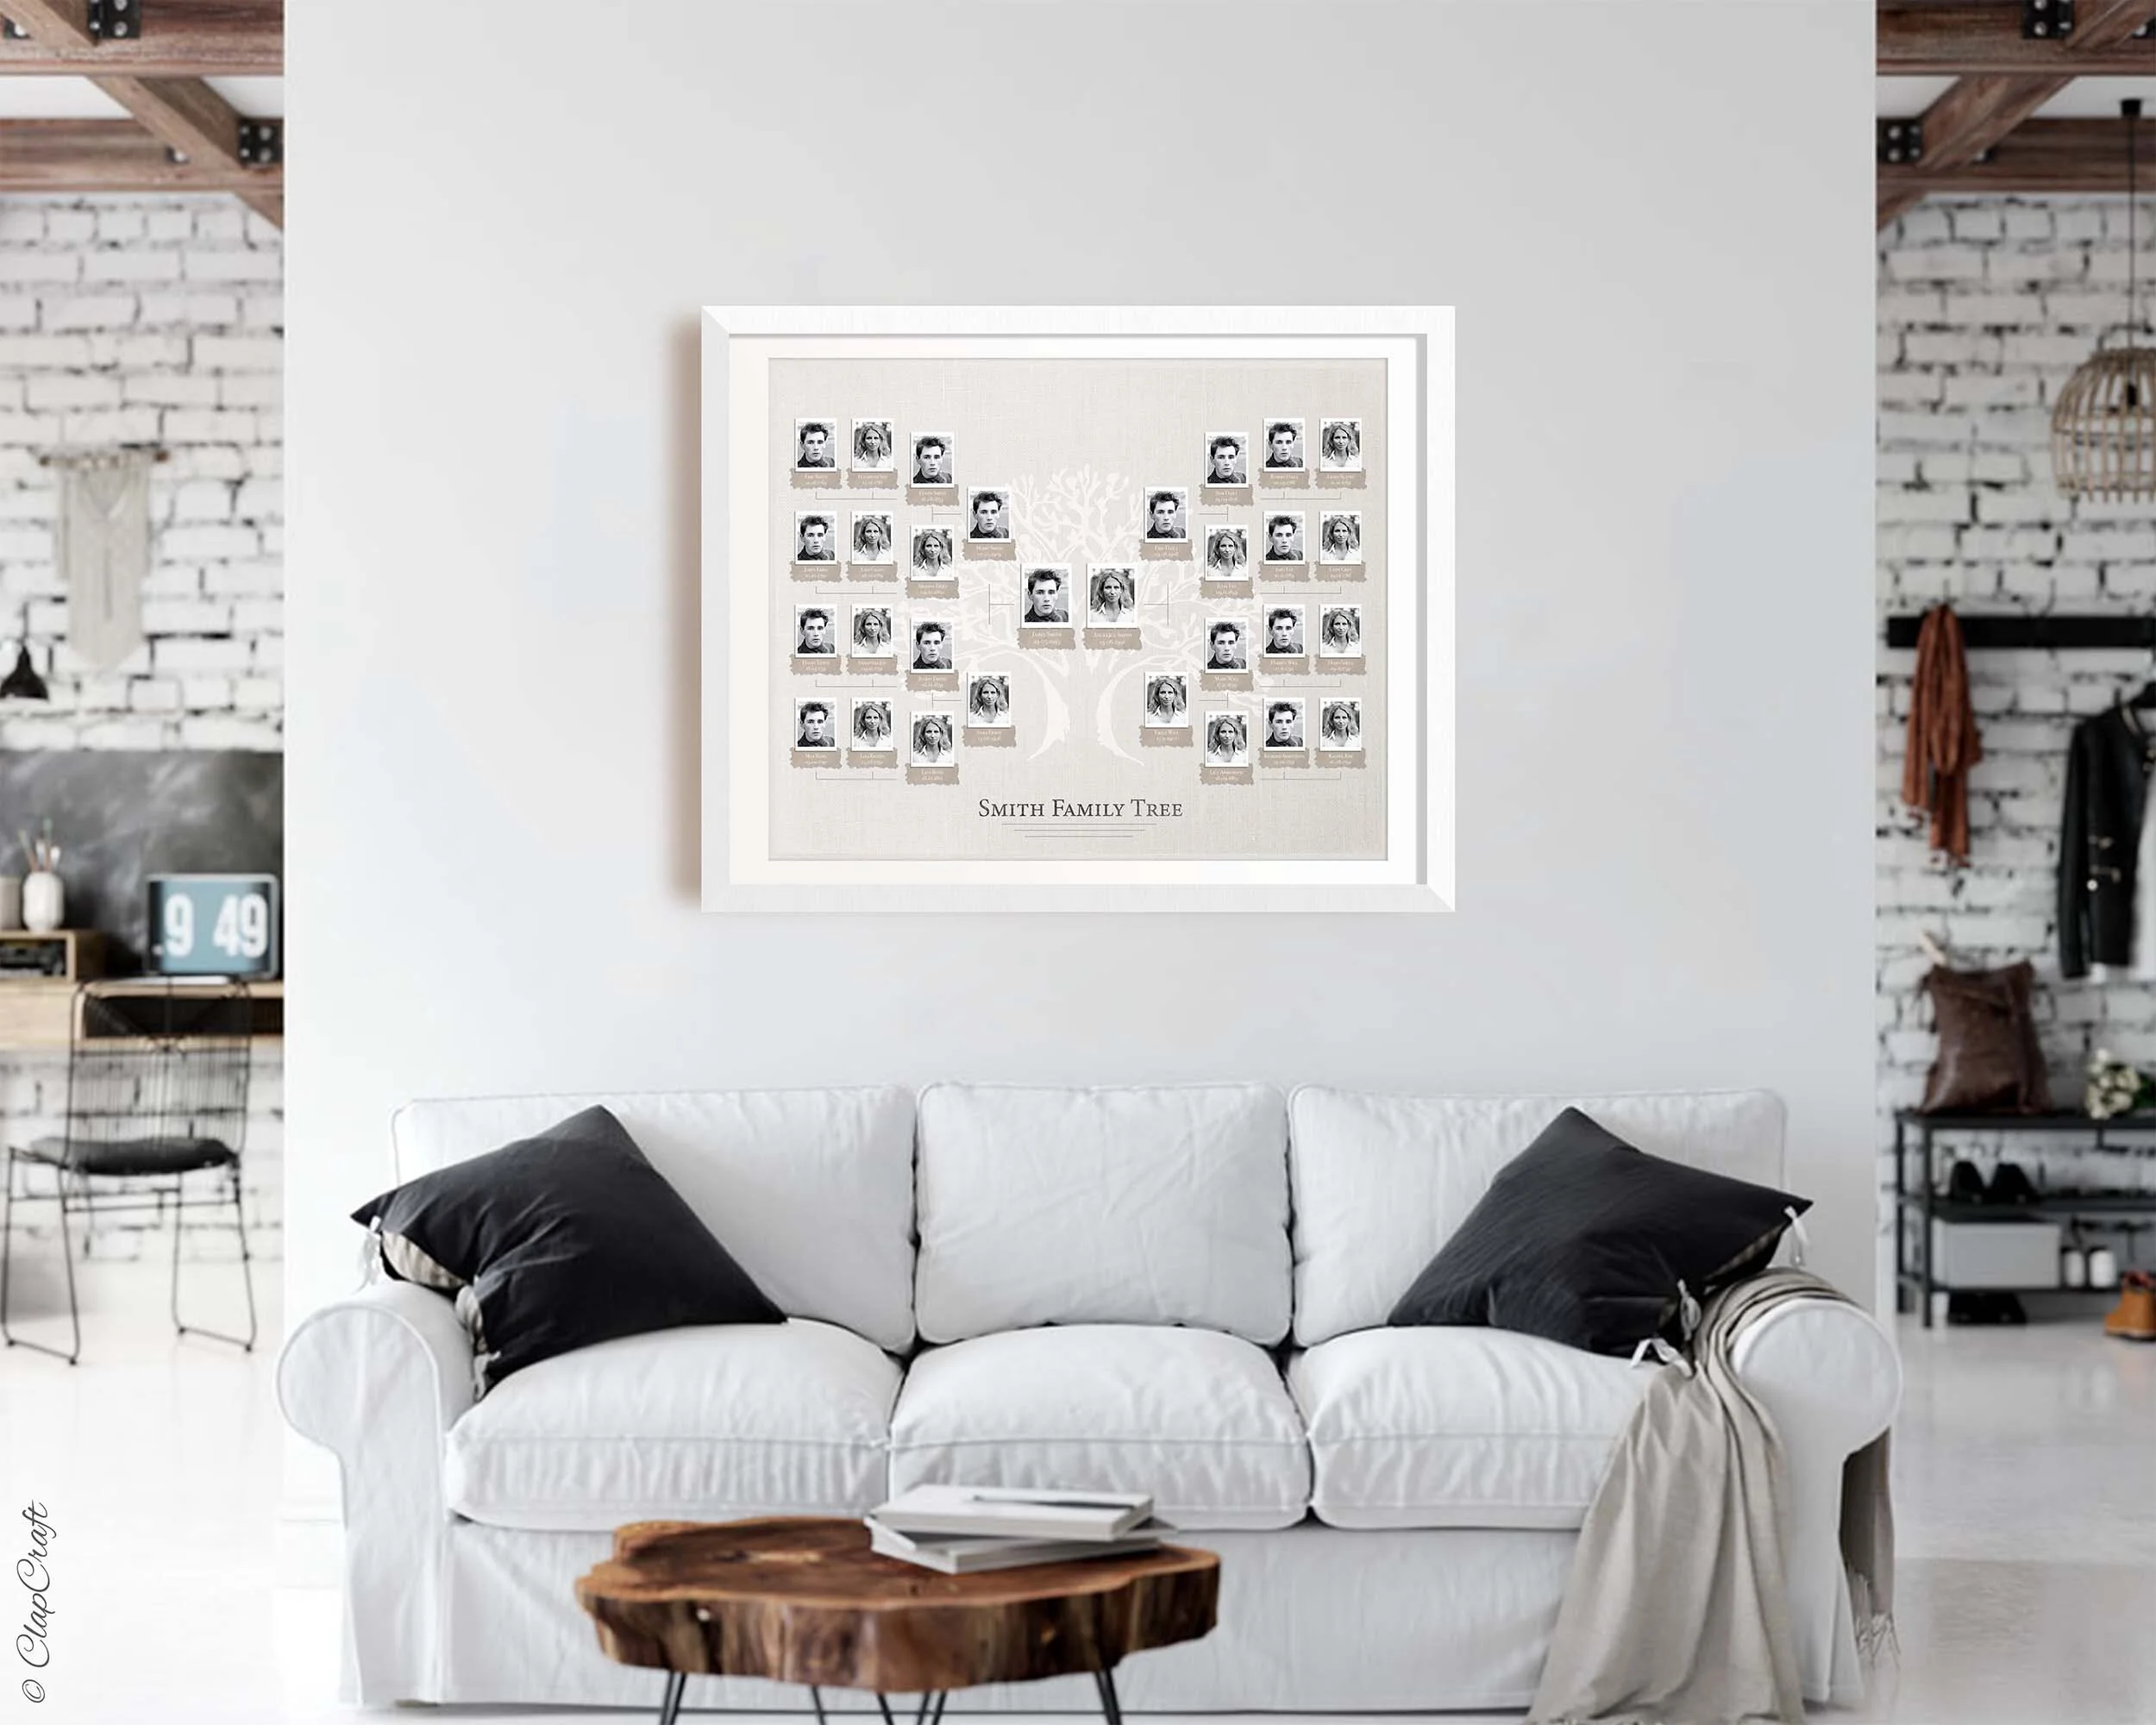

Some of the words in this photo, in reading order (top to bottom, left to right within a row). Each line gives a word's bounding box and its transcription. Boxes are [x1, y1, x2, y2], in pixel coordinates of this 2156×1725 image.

[978, 798, 1045, 818] SMITH
[1051, 798, 1125, 818] FAMILY
[1131, 798, 1183, 818] TREE
[213, 893, 268, 958] 49
